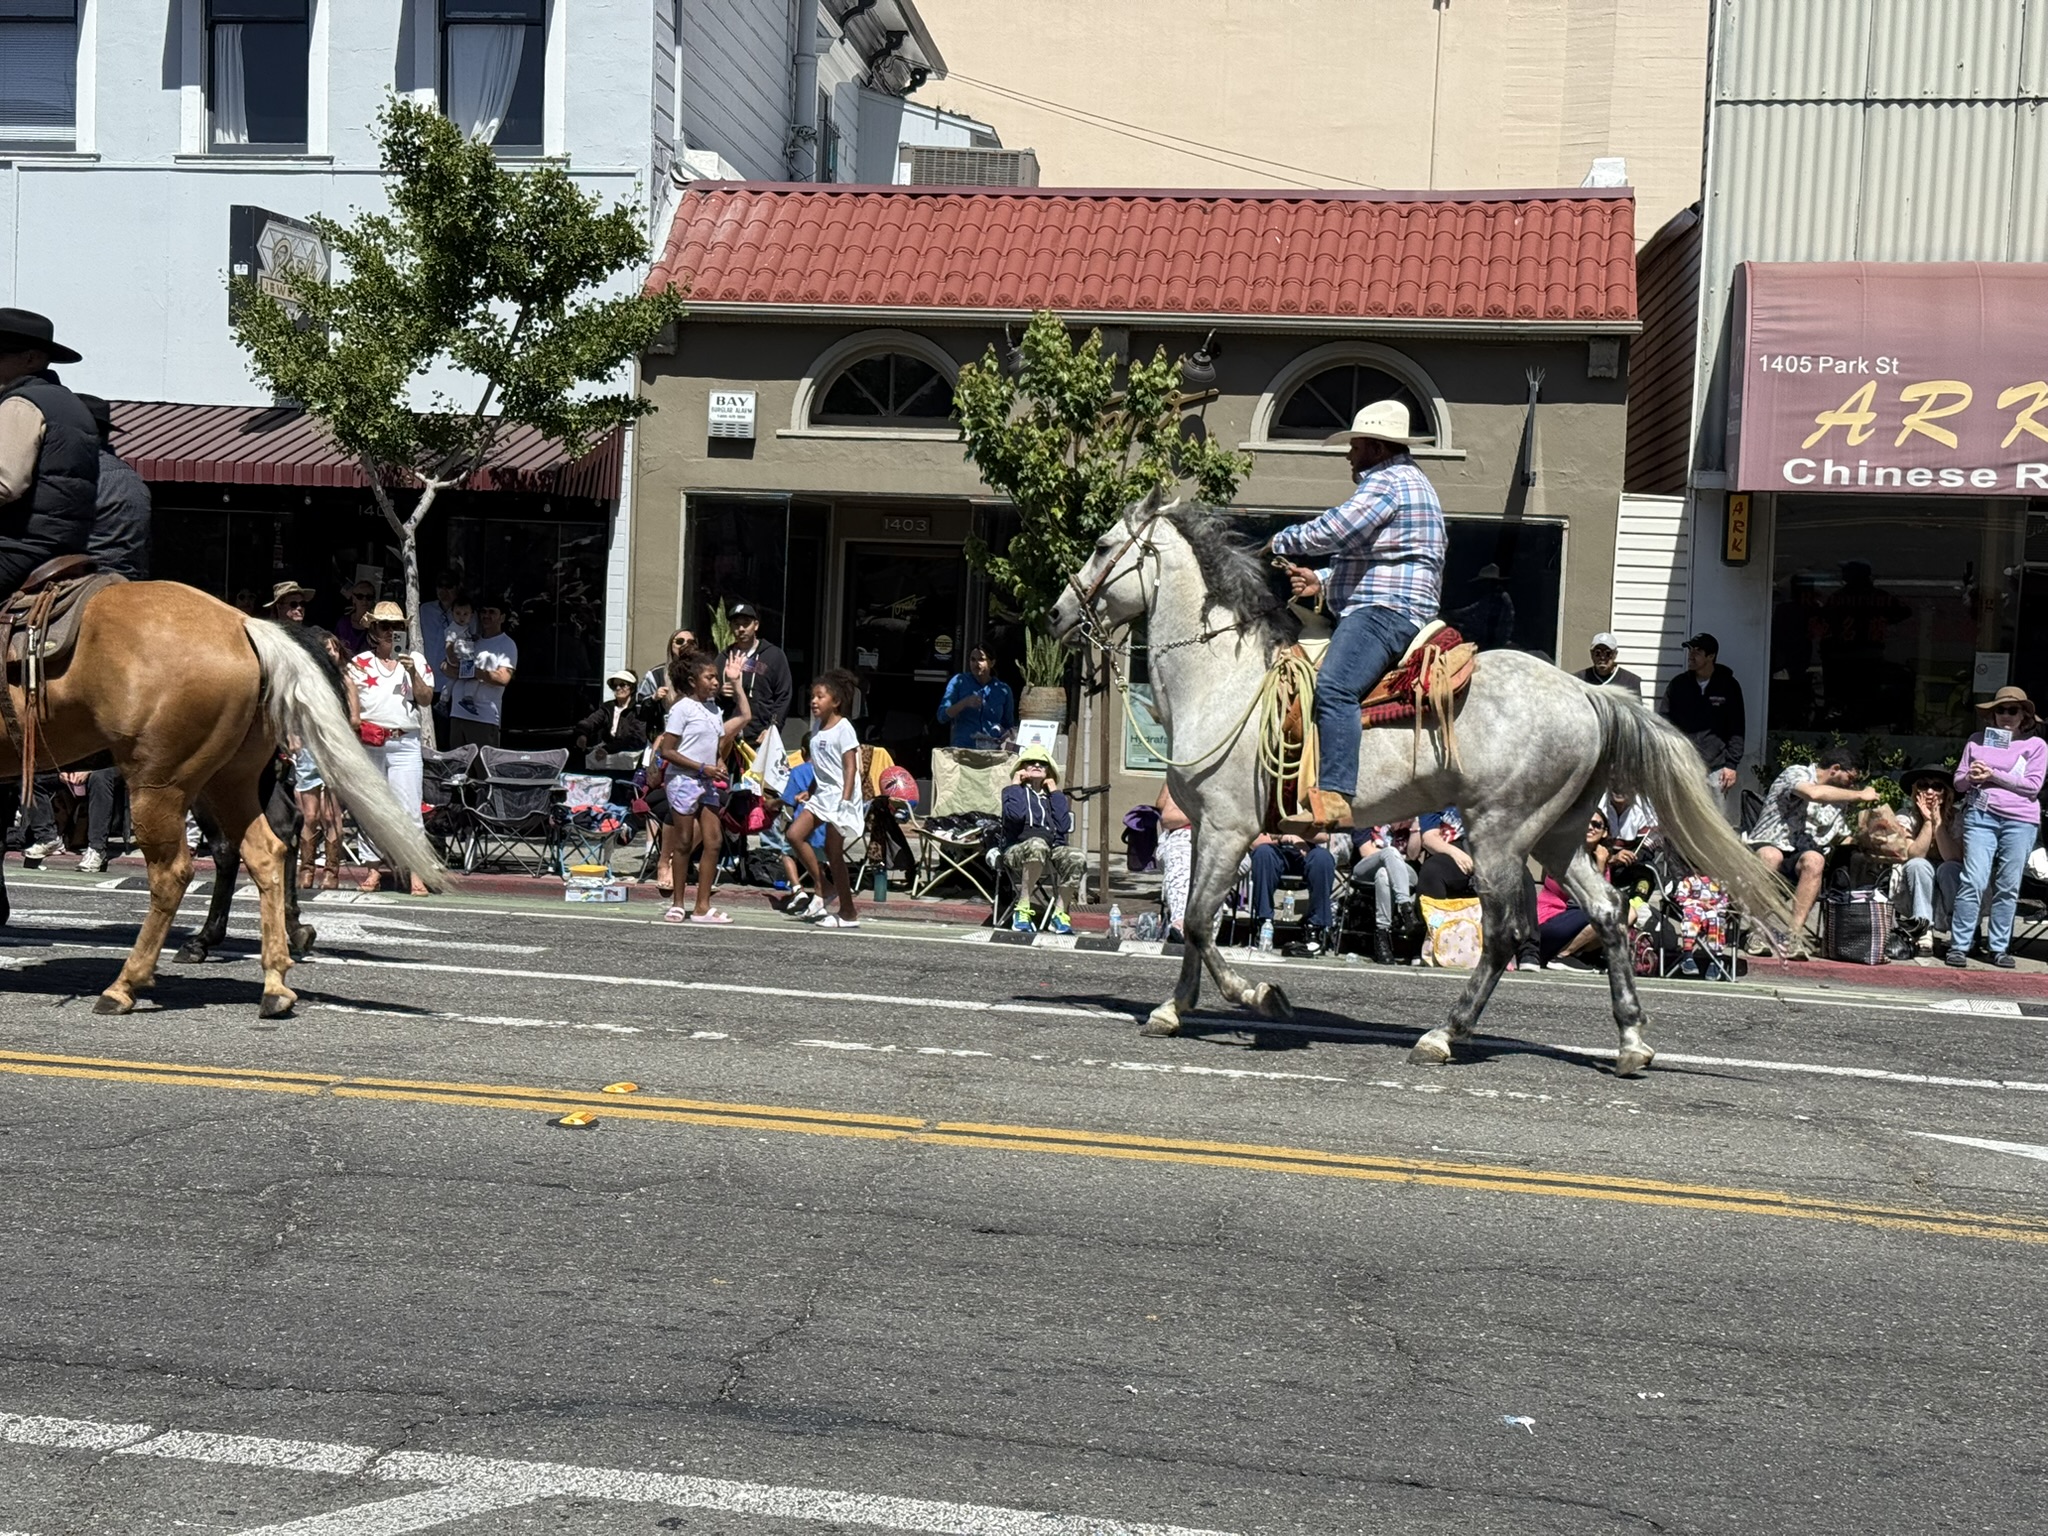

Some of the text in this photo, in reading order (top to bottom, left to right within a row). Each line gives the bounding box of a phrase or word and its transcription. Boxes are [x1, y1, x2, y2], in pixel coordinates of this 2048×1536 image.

[1759, 355, 1899, 375] 1405 Park St
[716, 396, 749, 406] BAY
[1783, 458, 1998, 488] Chinese
[358, 504, 385, 517] 140
[884, 518, 927, 532] 1403
